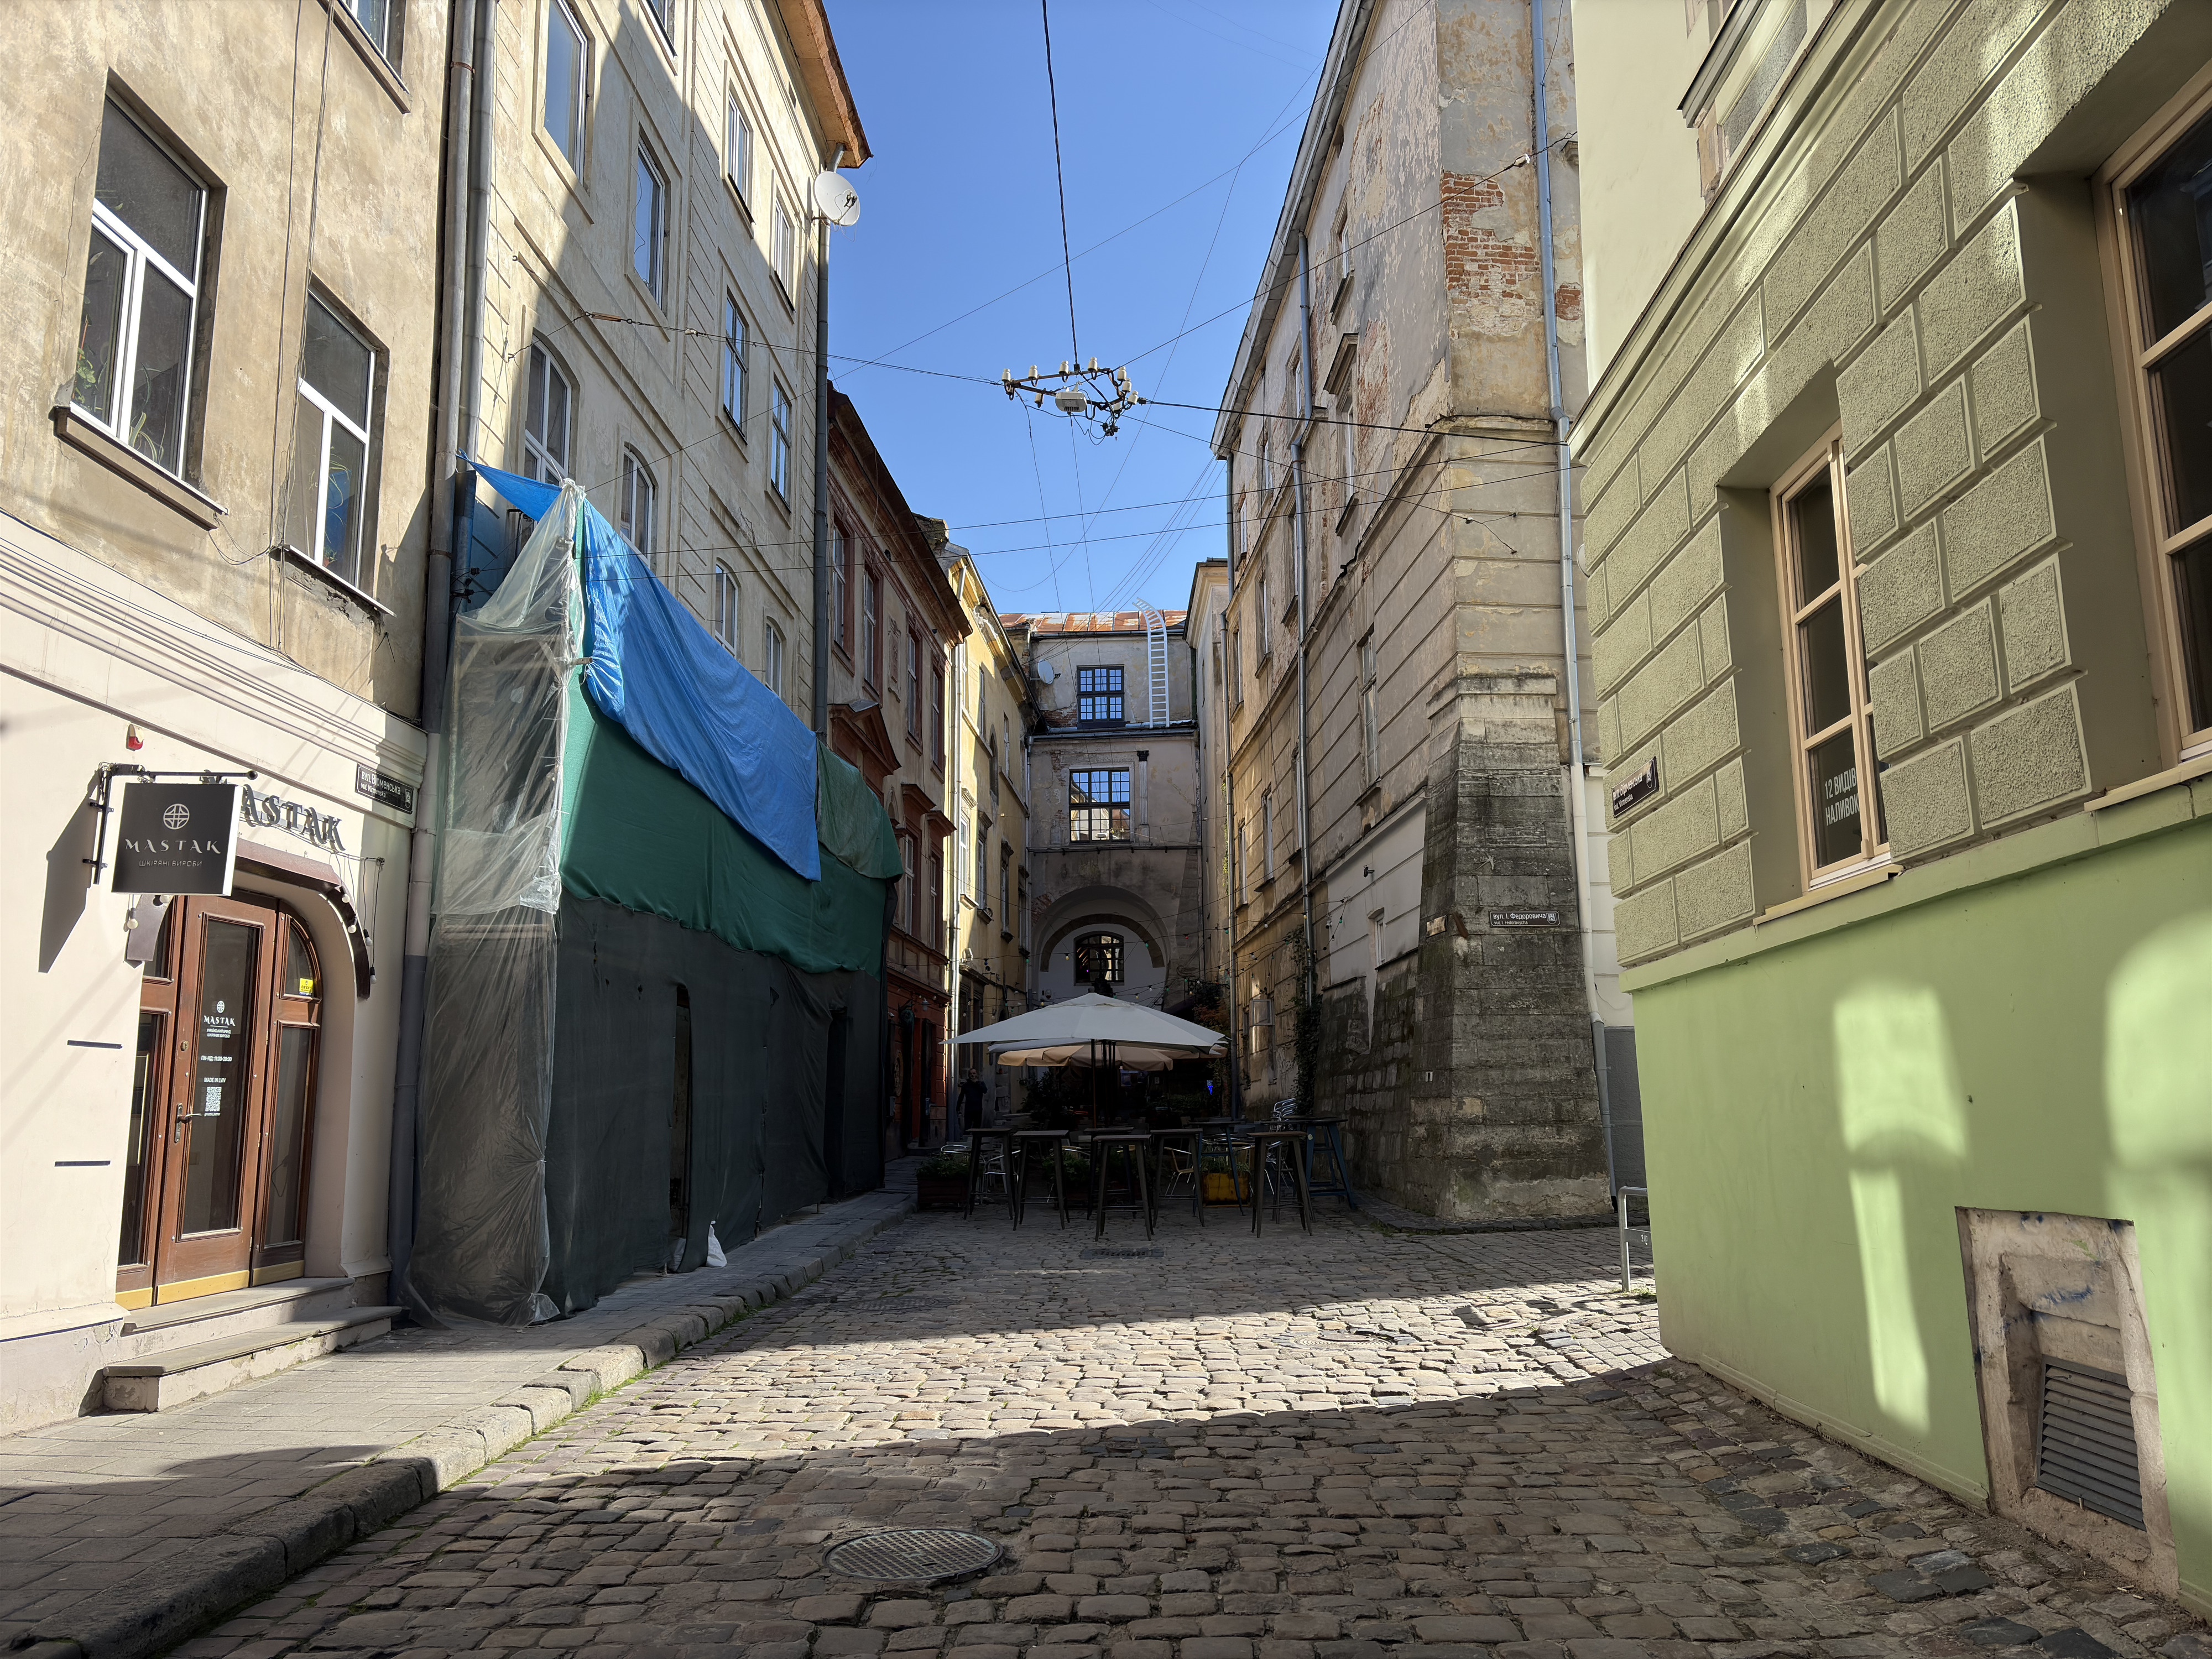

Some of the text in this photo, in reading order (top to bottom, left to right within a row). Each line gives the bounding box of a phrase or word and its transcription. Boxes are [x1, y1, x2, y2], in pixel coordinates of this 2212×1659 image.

[361, 771, 401, 795] вул. Вірменська
[368, 784, 386, 798] Virmenska
[1620, 773, 1642, 796] Вірменська
[1825, 768, 1856, 799] 12 ВИДІВ
[200, 769, 346, 851] ASTAK
[1618, 794, 1634, 807] Virmenska
[1825, 793, 1860, 826] НАЛИВОК
[125, 839, 221, 854] MASTAK
[204, 1015, 236, 1026] MASTAK
